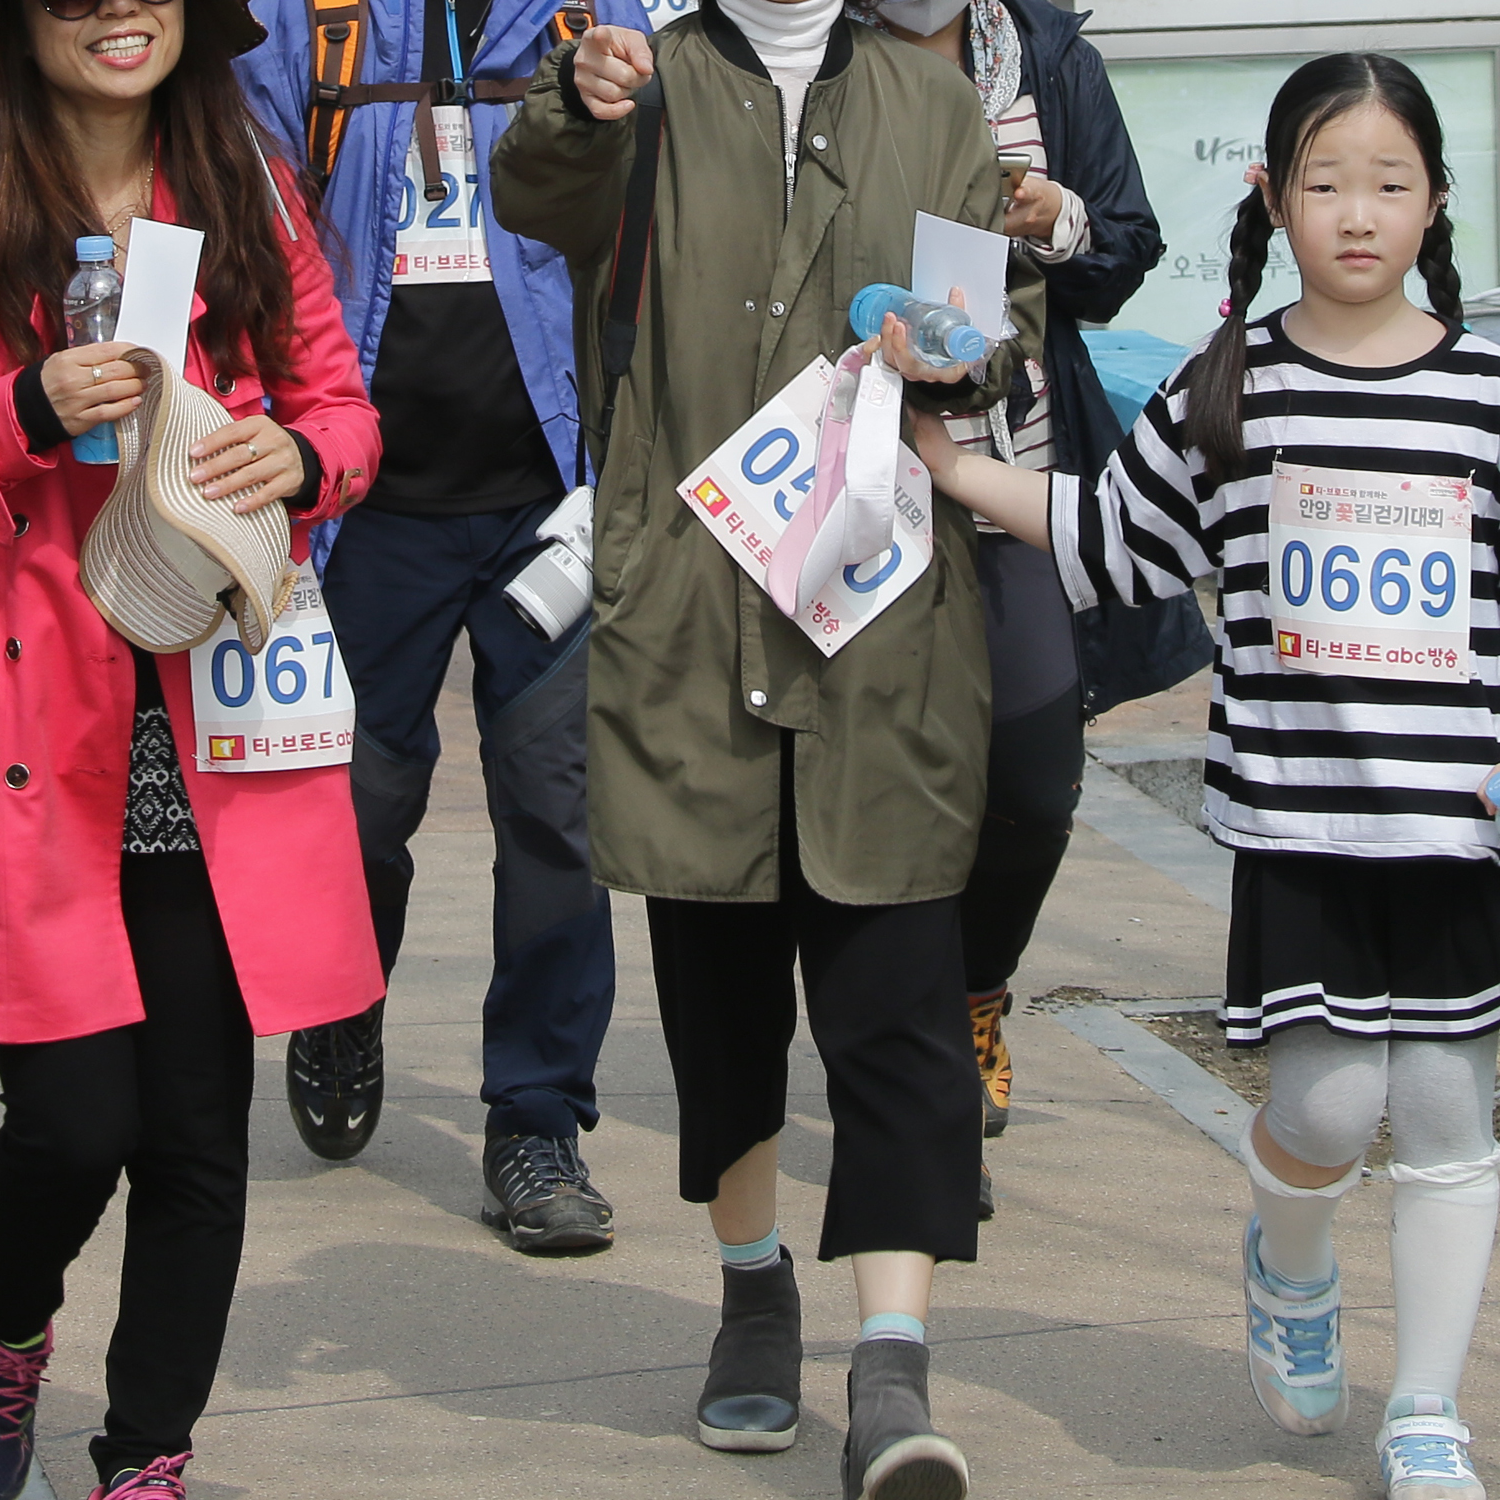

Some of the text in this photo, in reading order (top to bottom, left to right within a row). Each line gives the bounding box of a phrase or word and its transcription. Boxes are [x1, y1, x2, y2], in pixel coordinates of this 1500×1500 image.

[1299, 498, 1444, 528] 안양 꽃길걷기대회
[1281, 540, 1457, 618] 0669
